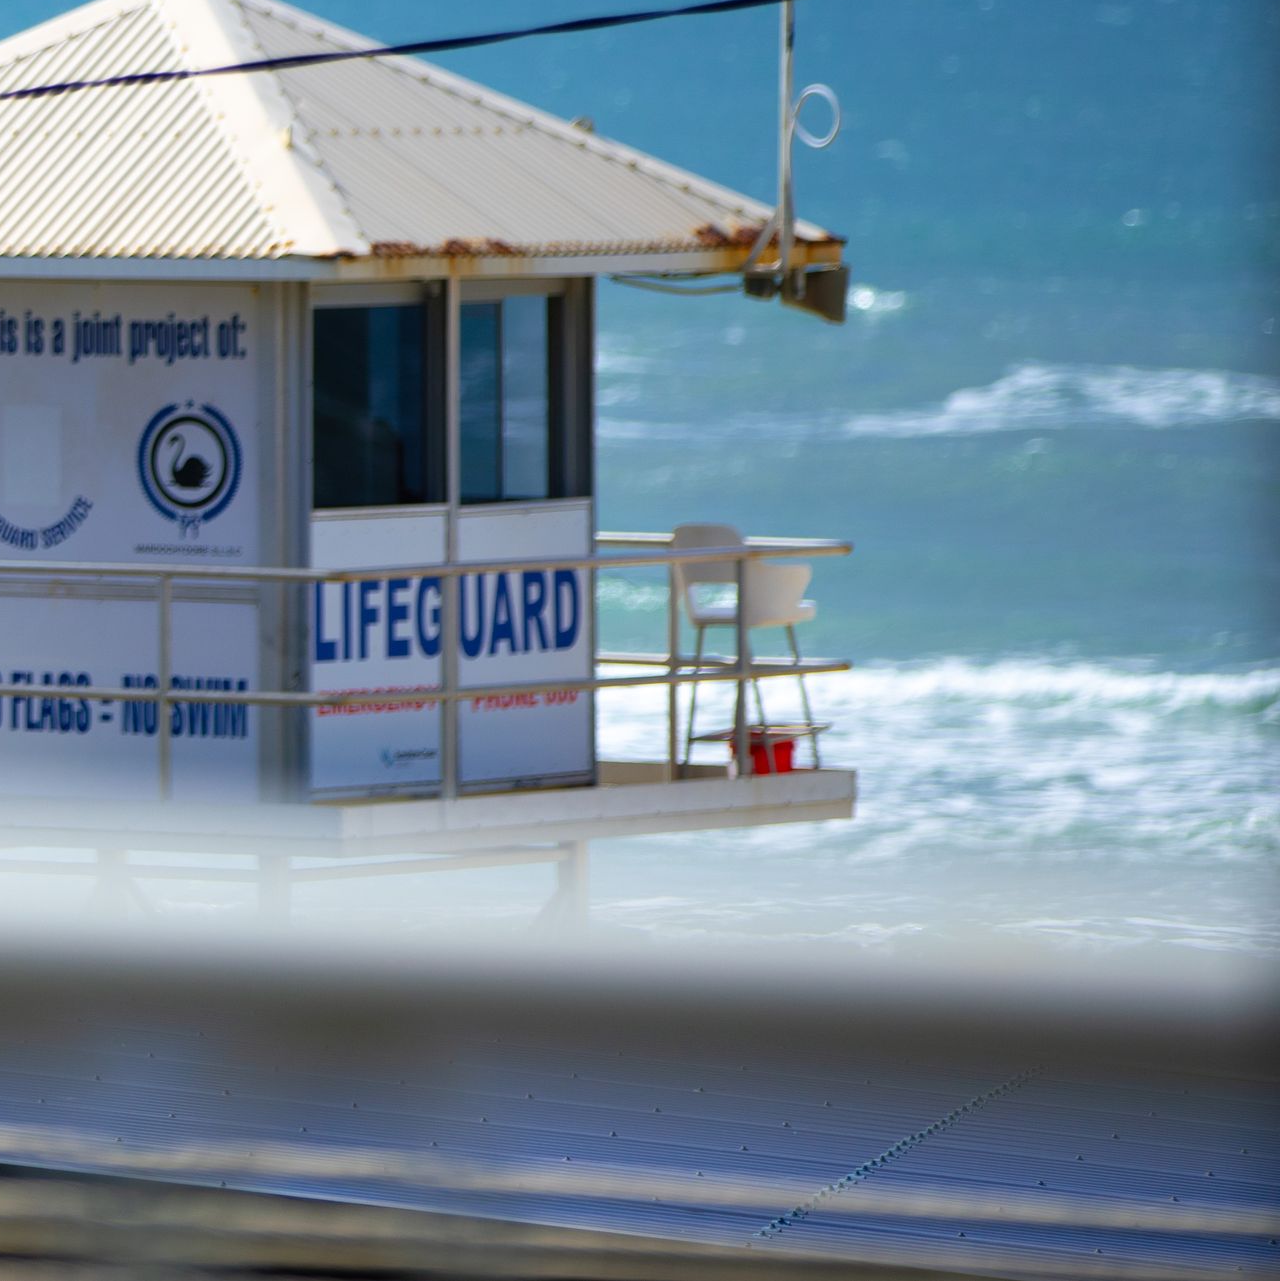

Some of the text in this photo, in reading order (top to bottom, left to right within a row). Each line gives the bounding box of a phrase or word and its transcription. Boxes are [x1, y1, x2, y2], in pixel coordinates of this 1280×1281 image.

[25, 310, 44, 354] is
[52, 318, 65, 355] a
[72, 312, 123, 363] joint
[128, 312, 210, 366] project
[41, 495, 94, 550] SERVICE
[314, 570, 581, 662] LIFEGUARD
[9, 671, 92, 734] FLAGS
[121, 674, 160, 735] NO
[170, 676, 249, 739] SWIM
